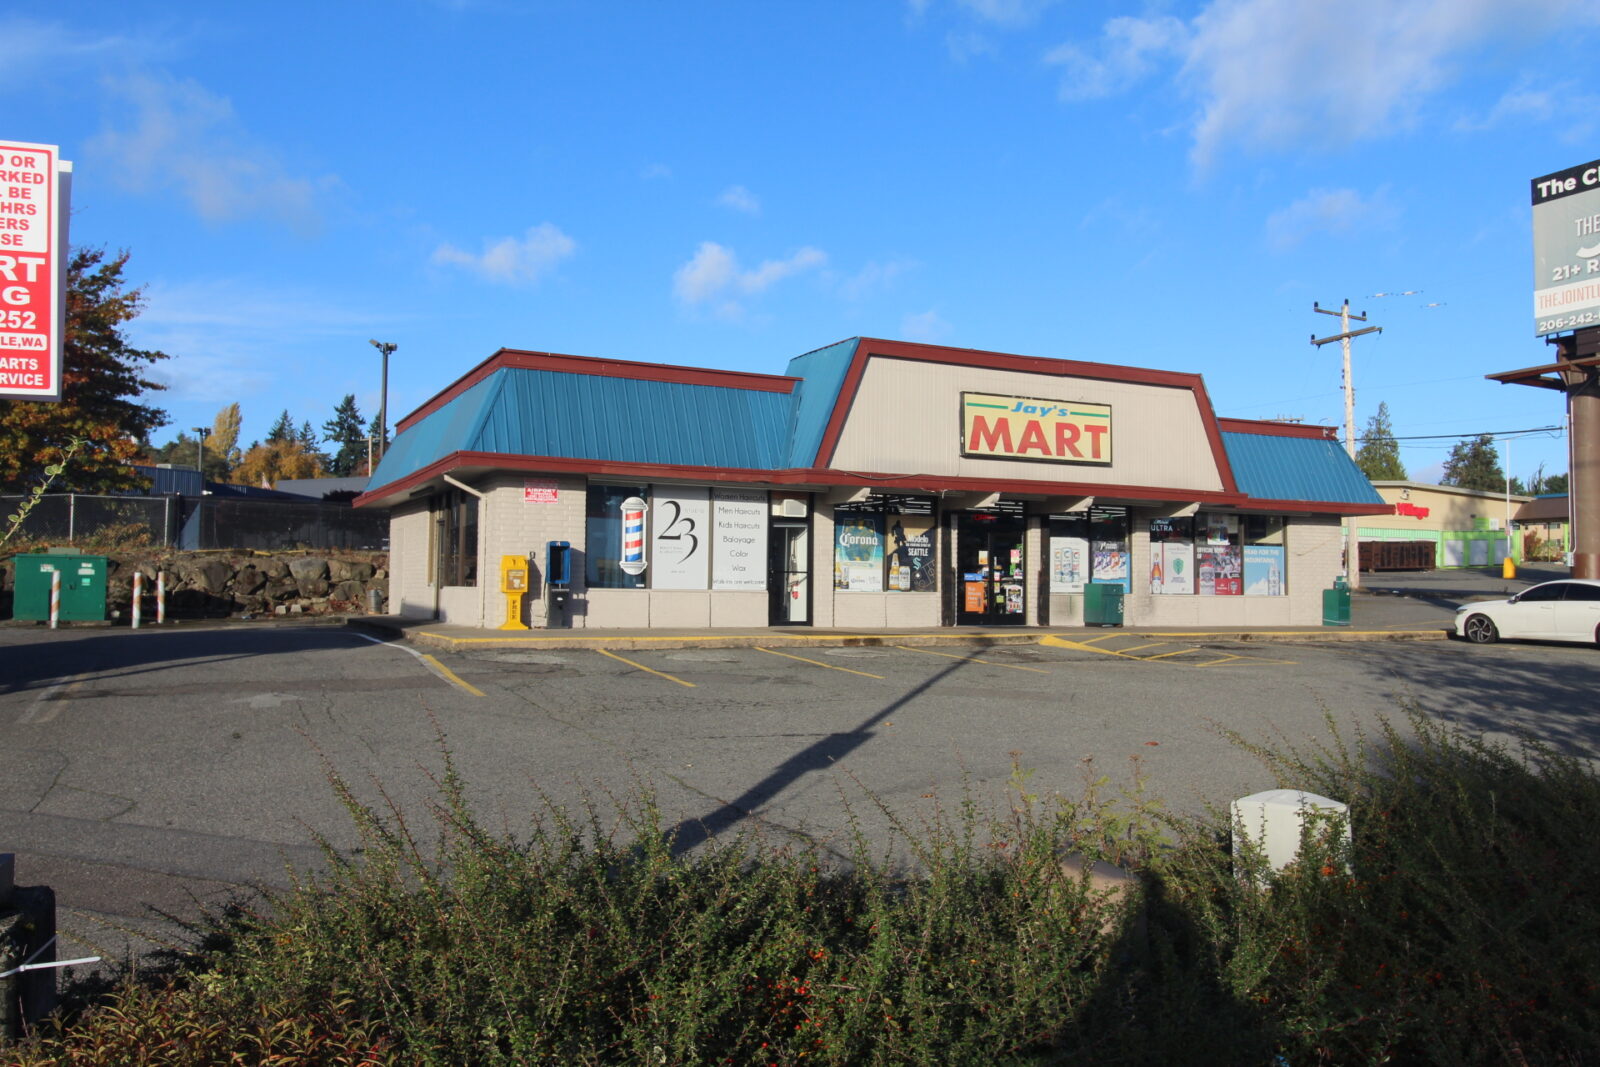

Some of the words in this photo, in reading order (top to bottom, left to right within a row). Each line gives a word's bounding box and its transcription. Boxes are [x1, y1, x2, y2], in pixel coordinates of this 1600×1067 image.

[10, 155, 36, 169] OR
[1537, 178, 1577, 198] The
[1582, 165, 1600, 186] C
[8, 186, 31, 199] BE
[1, 233, 24, 246] SE
[1552, 264, 1581, 281] 21+
[2, 285, 31, 306] G
[1538, 283, 1600, 310] THEJOINTL
[1539, 311, 1600, 332] 206-242-
[1011, 401, 1069, 418] Jay's
[969, 415, 1108, 459] MART
[718, 506, 734, 514] Men
[734, 506, 761, 516] Haircuts
[718, 521, 732, 529] Kids
[733, 522, 761, 530] Haircuts
[1150, 524, 1174, 532] ULTRA
[722, 535, 756, 544] Balayage
[839, 531, 878, 549] Corona
[730, 549, 748, 558] Color
[907, 547, 929, 557] SEATTLE
